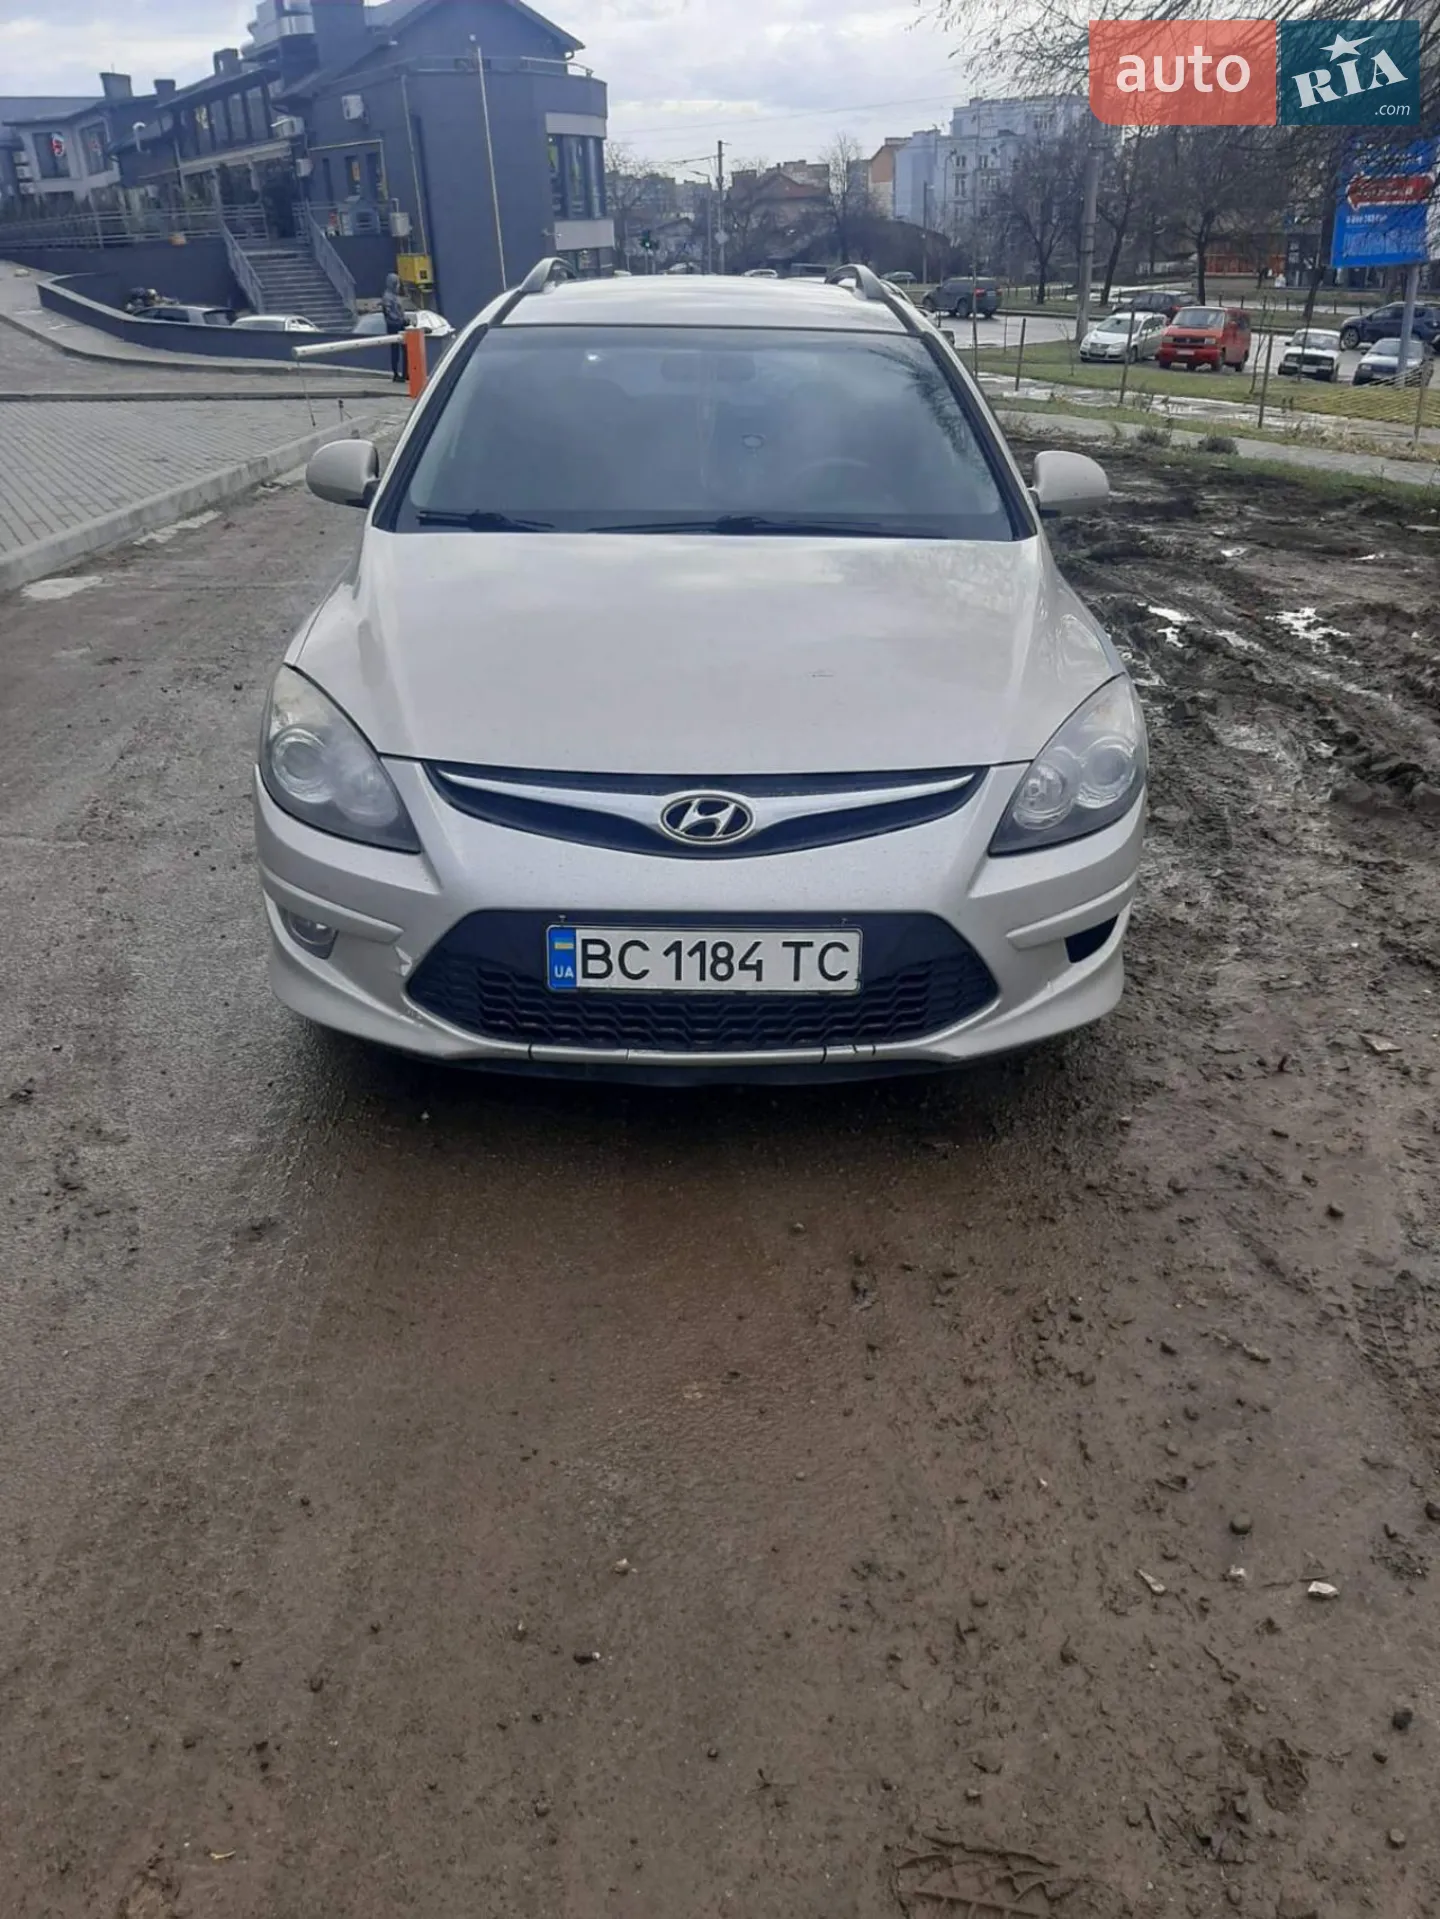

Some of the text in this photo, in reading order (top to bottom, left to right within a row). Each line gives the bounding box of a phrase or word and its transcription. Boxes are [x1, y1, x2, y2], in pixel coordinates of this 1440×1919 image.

[554, 964, 574, 979] UA
[580, 938, 850, 983] BC 1184 TC
